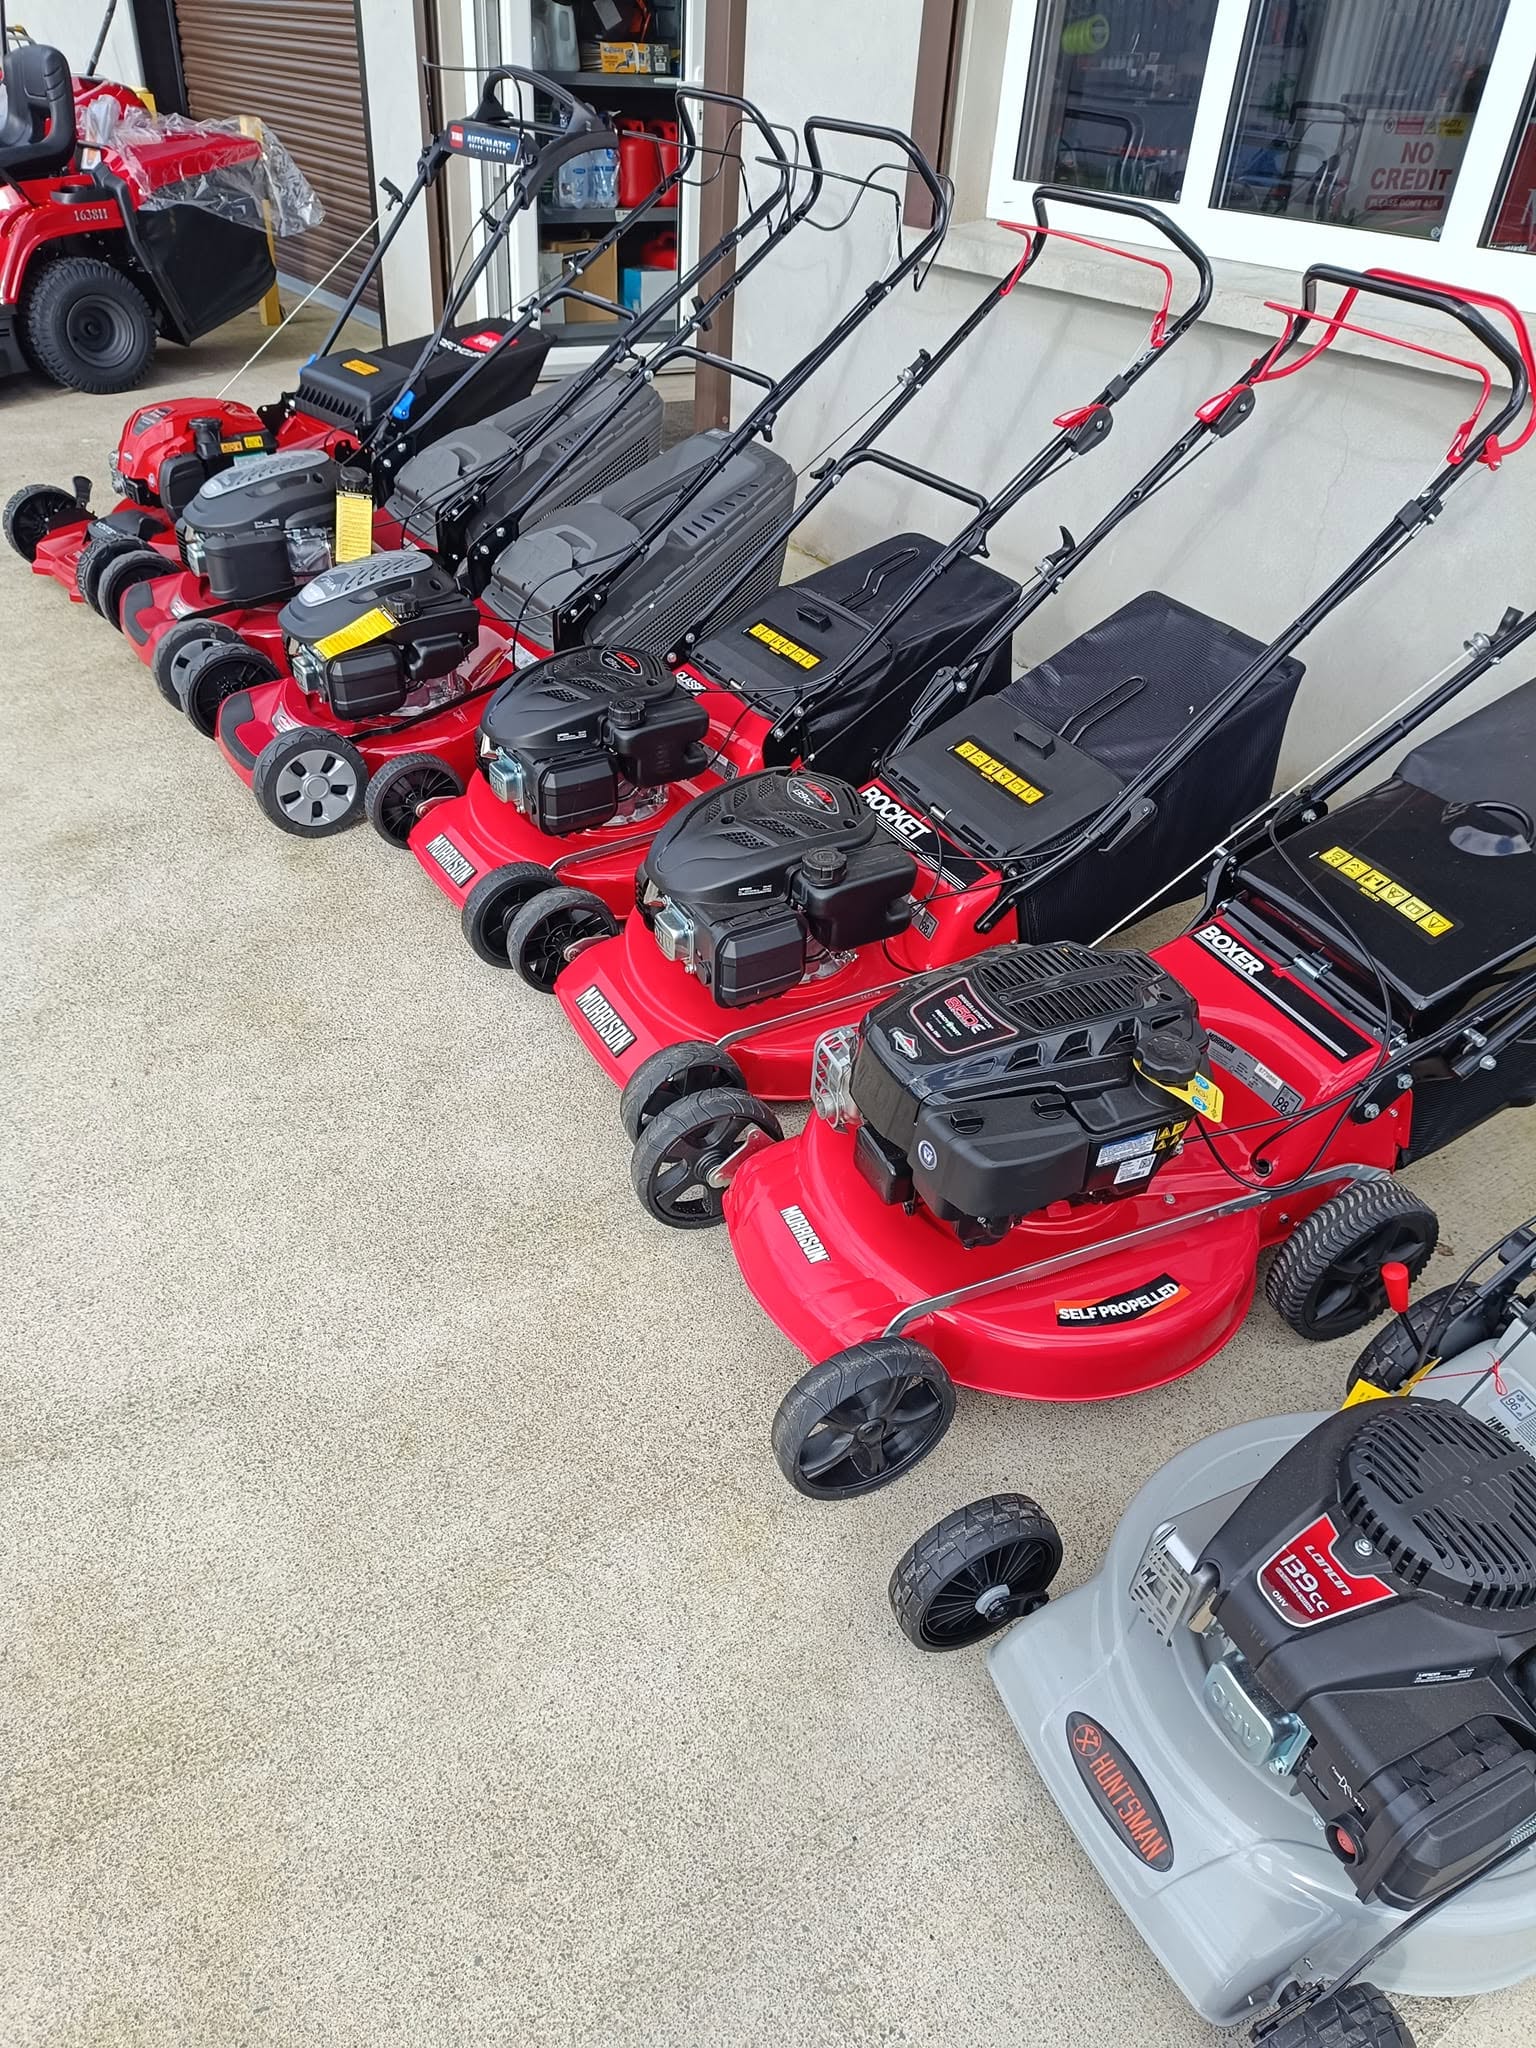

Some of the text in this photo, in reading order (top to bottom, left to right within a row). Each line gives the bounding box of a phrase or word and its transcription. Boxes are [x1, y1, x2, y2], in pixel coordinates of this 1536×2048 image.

[467, 134, 511, 150] AUTOMATIC
[1400, 141, 1434, 164] NO
[1370, 167, 1453, 190] CREDIT
[860, 786, 933, 840] ROCKET
[425, 833, 475, 885] MORRISON
[1198, 924, 1265, 976] BOXER
[575, 985, 636, 1054] MORRISON
[1276, 1096, 1290, 1113] 98
[780, 1204, 830, 1264] MORRISON
[1058, 1283, 1180, 1320] SELF PROPELLED
[1505, 1397, 1521, 1411] 96
[1272, 1590, 1289, 1608] OHV
[1279, 1553, 1330, 1613] 139cc
[1089, 1752, 1168, 1862] HUNTSMAN
